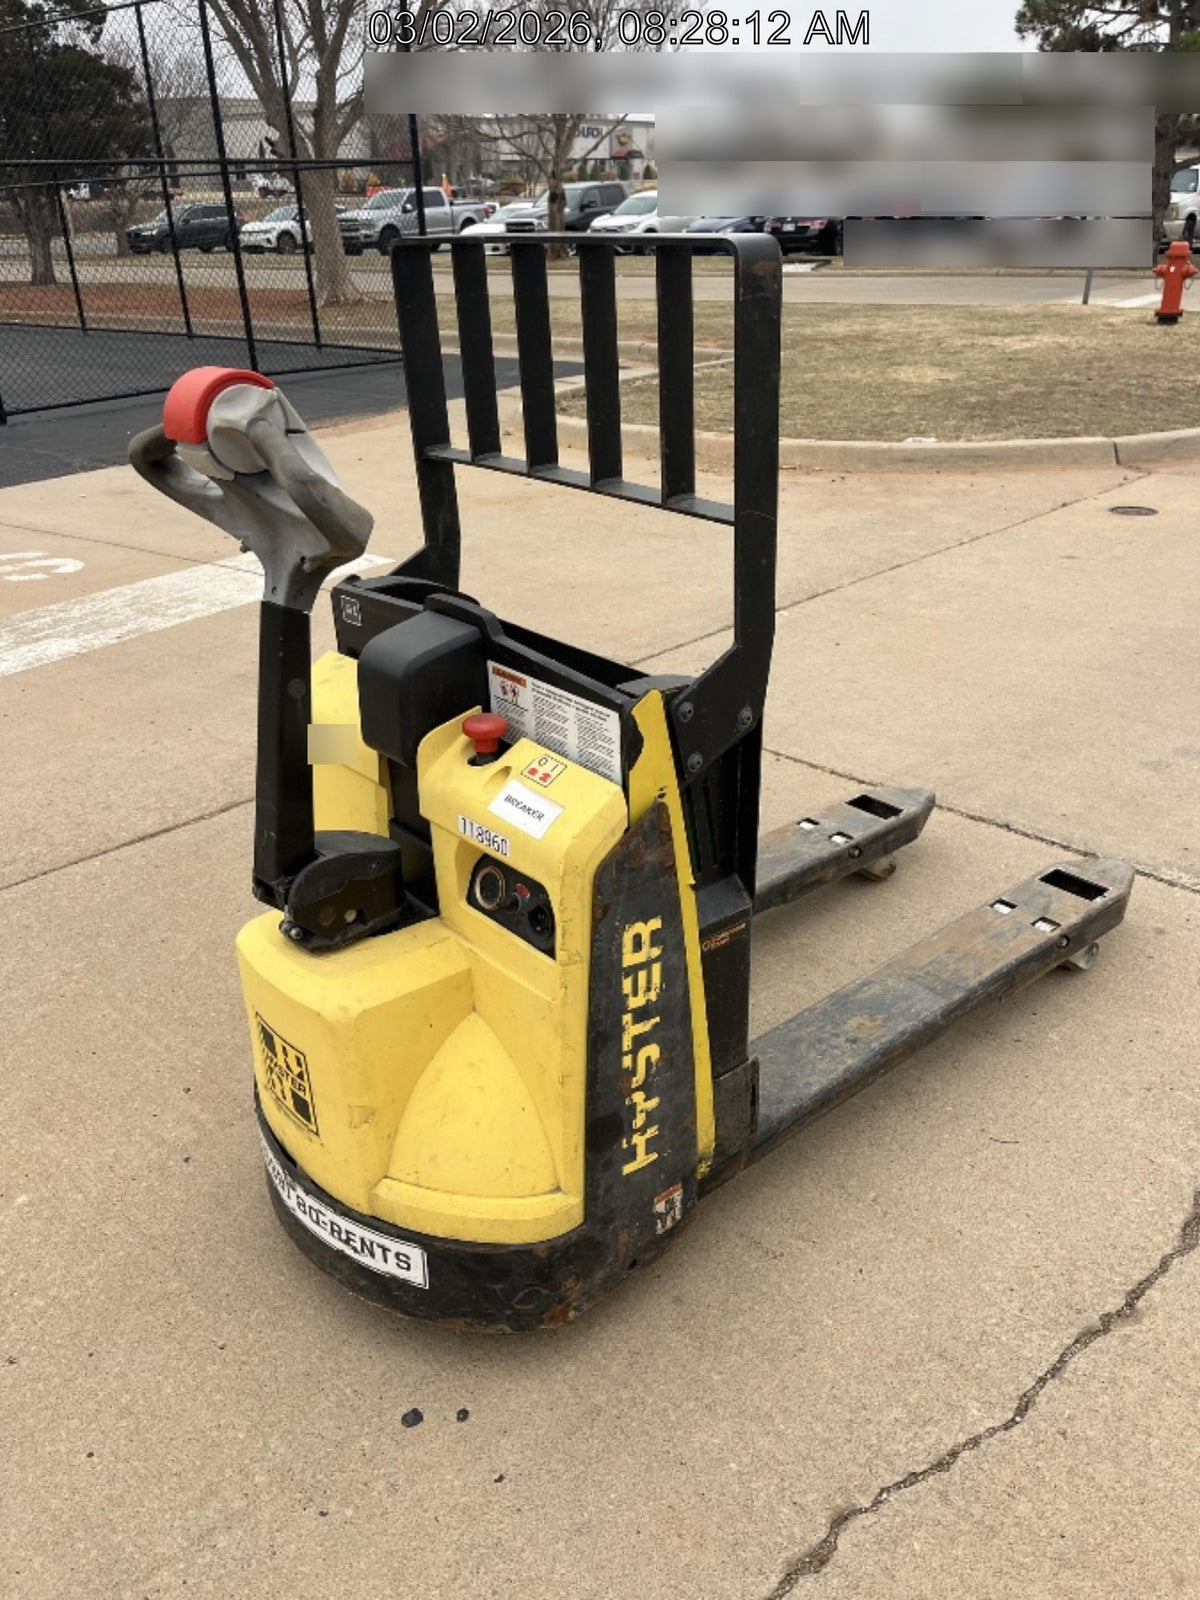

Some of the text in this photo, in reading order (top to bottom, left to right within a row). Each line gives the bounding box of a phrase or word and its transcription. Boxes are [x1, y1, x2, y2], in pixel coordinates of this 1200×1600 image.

[575, 126, 604, 138] HURCH
[503, 794, 545, 821] BREAKER
[460, 817, 508, 855] 118960
[621, 915, 663, 1177] HYSTER
